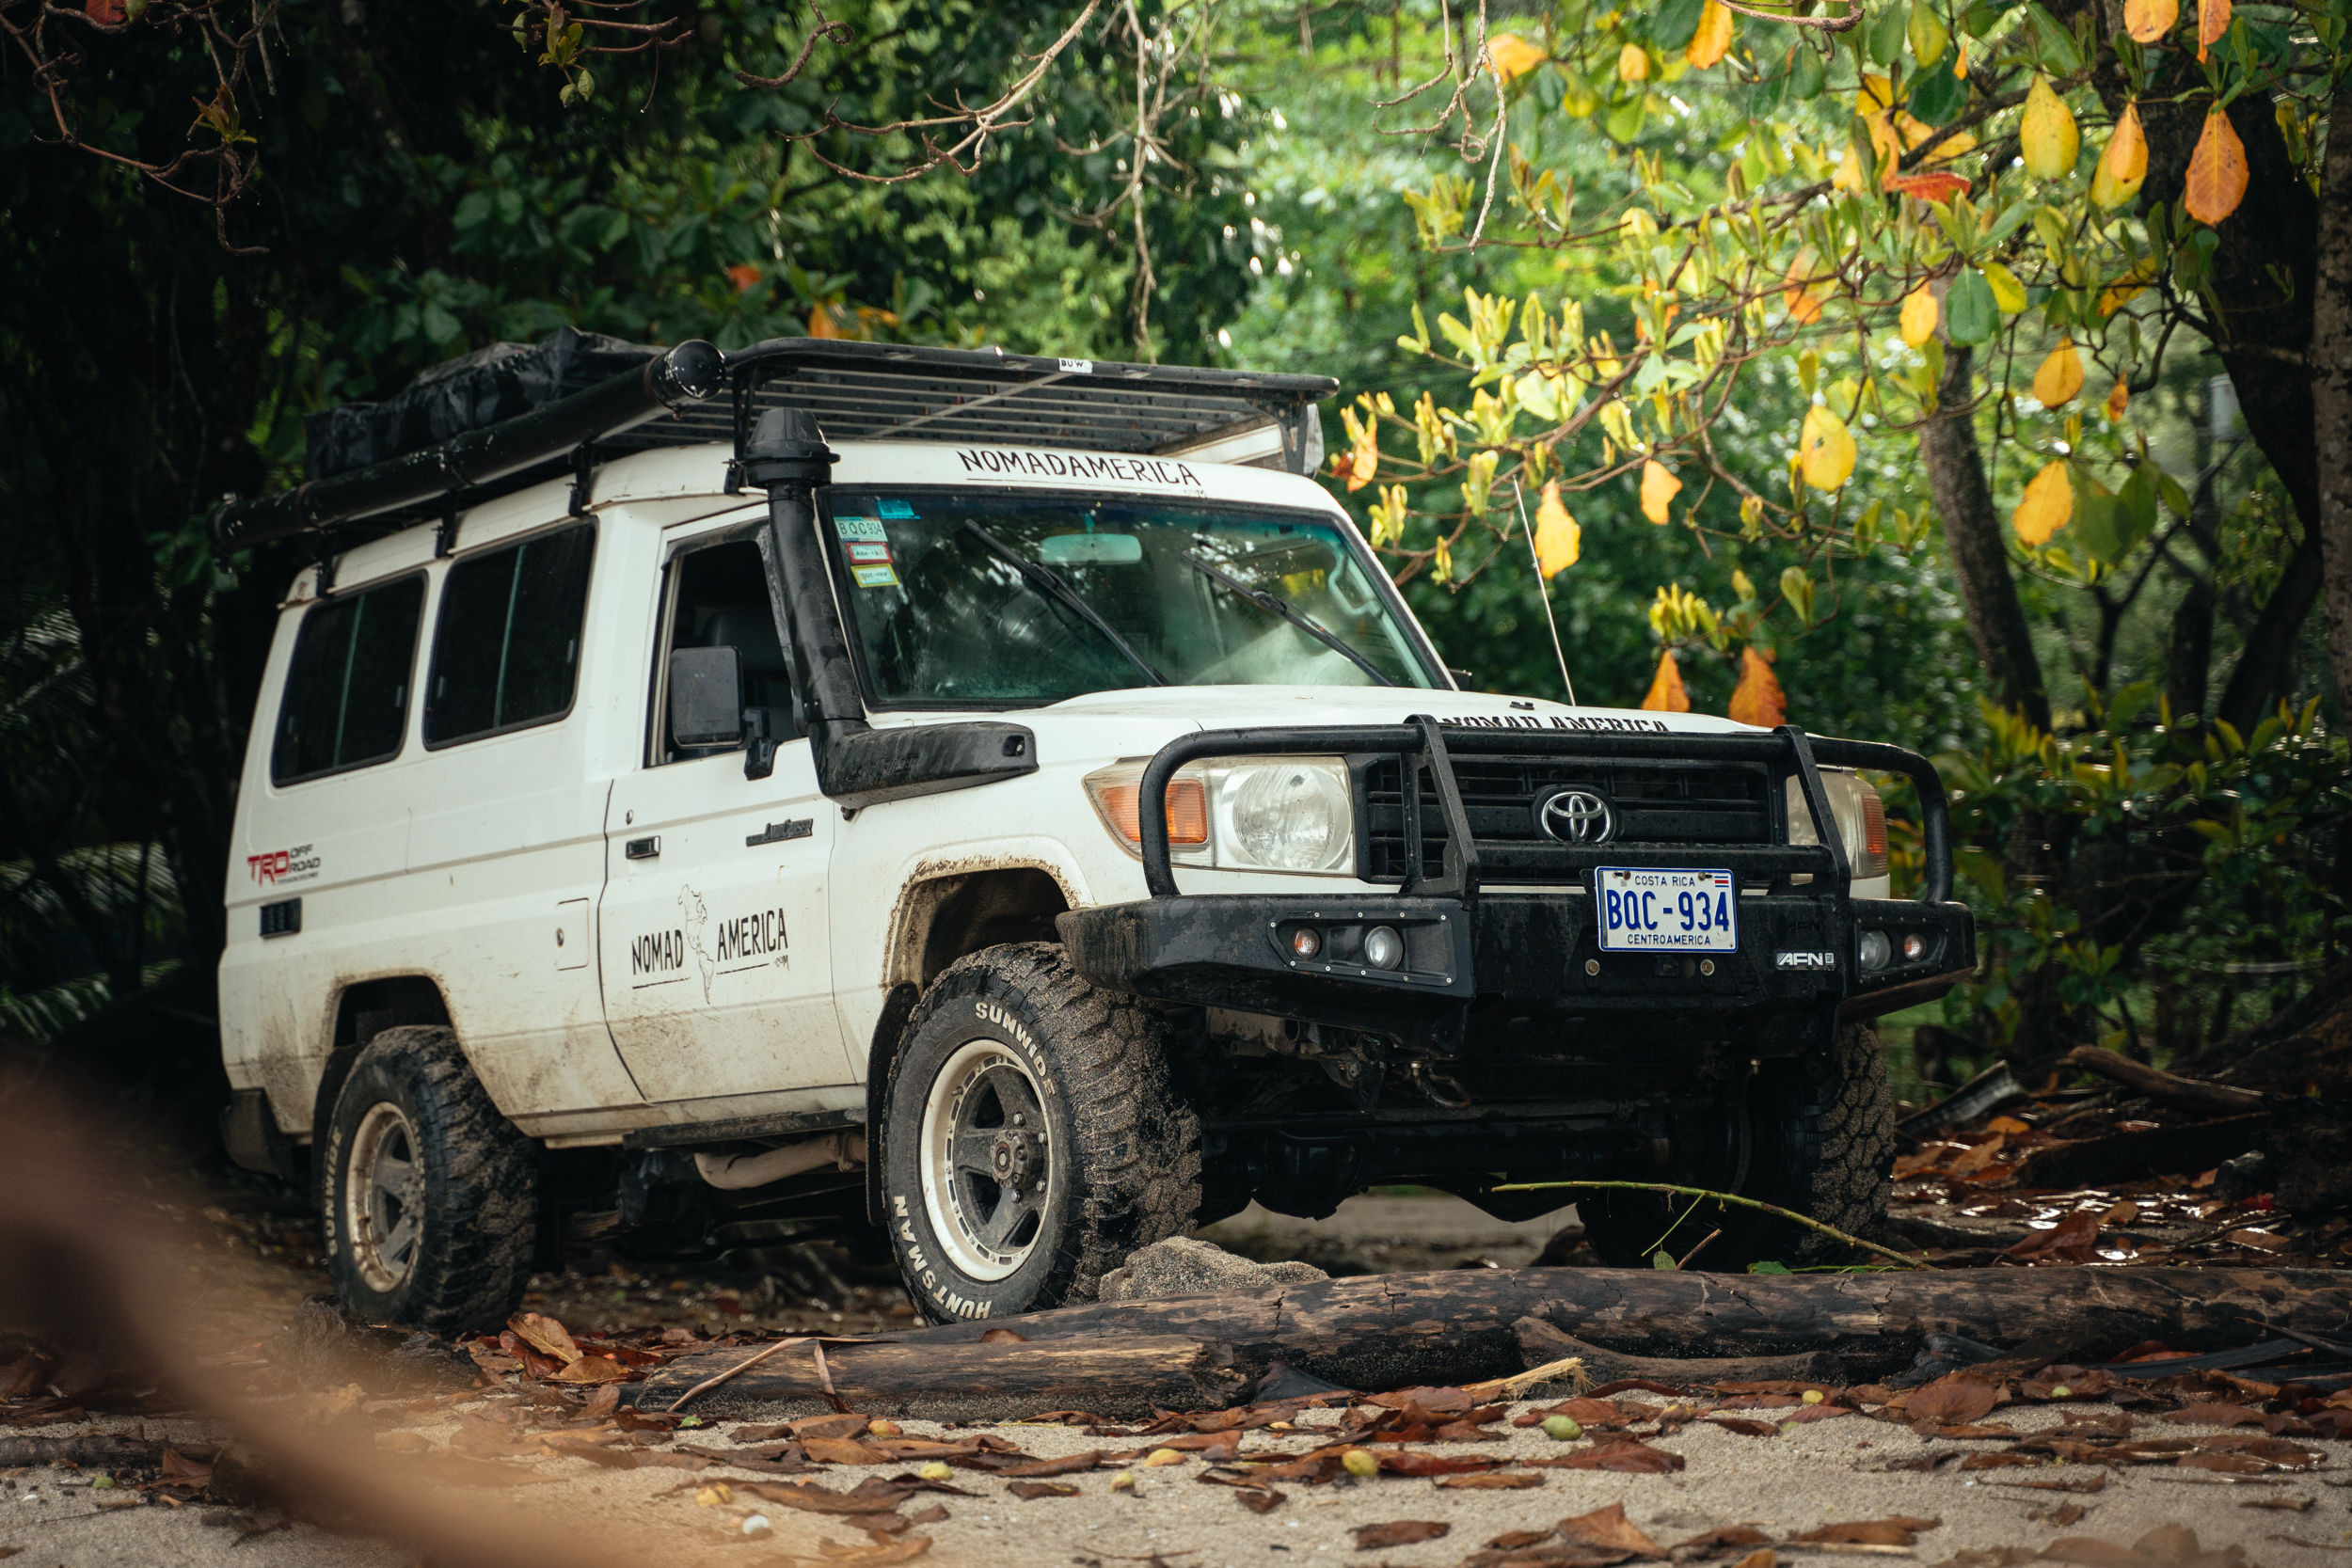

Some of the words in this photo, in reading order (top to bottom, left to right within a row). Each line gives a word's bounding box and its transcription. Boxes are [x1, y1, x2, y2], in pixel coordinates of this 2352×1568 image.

[955, 450, 1202, 487] NOMADAMERICA
[246, 849, 290, 889] TRD
[289, 857, 321, 873] ROAD
[290, 844, 313, 859] OFF
[1634, 876, 1667, 886] COSTA
[1672, 876, 1695, 887] RICA
[1606, 889, 1729, 932] BQC-934
[631, 929, 684, 975] NOMAD
[717, 908, 788, 962] AMERICA
[1627, 934, 1711, 945] CENTROAMERICA
[1776, 952, 1823, 966] AFN
[975, 1001, 1057, 1099] SUNWIDE
[893, 1195, 993, 1320] HUNTSMAN
